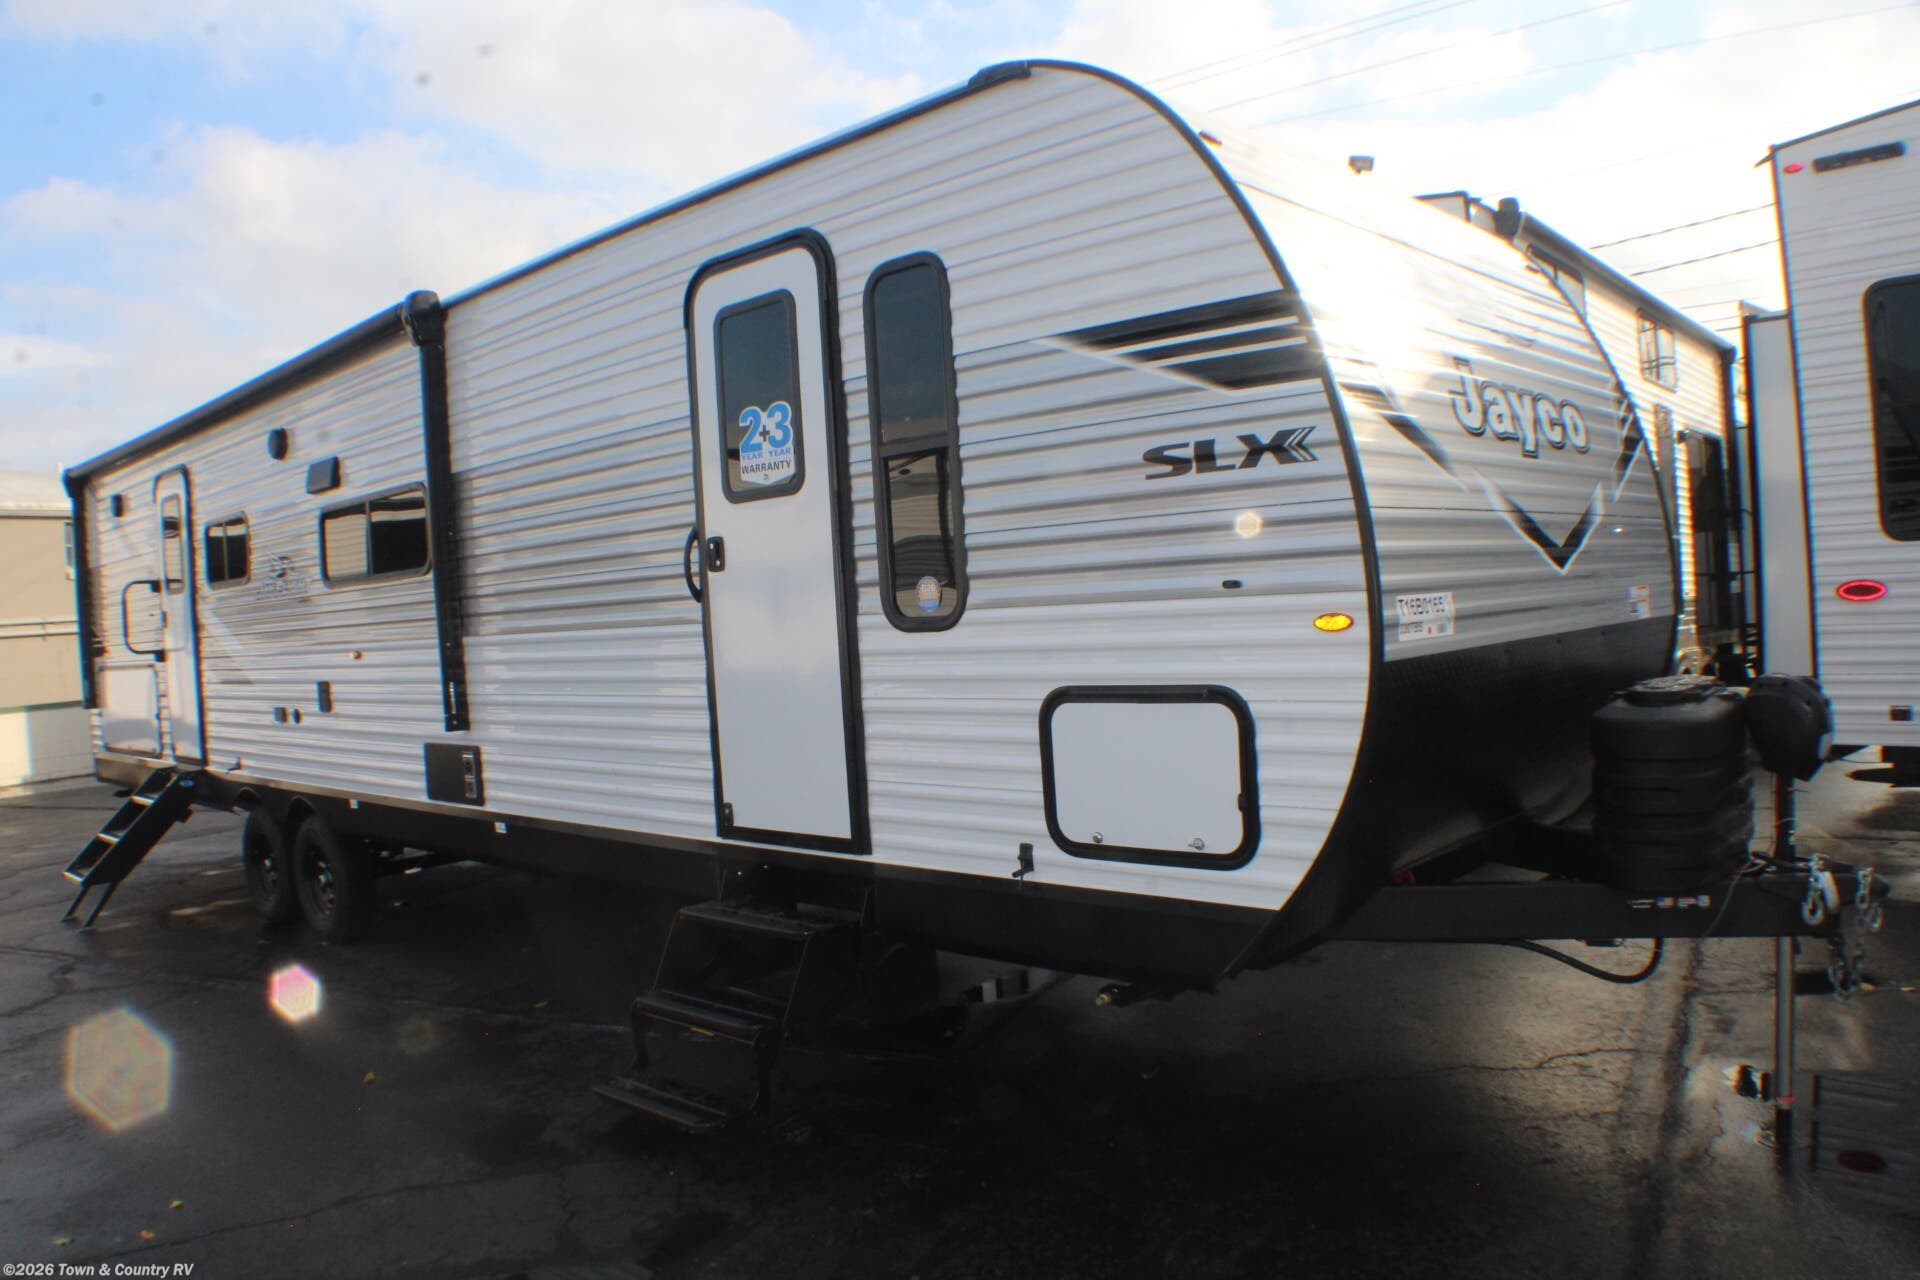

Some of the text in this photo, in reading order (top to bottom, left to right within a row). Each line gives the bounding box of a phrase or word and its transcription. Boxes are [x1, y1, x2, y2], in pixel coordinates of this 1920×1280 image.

[1449, 357, 1590, 459] Jayco
[741, 460, 792, 474] WARRANTY
[768, 448, 791, 457] YEAR
[1143, 426, 1319, 480] SLX
